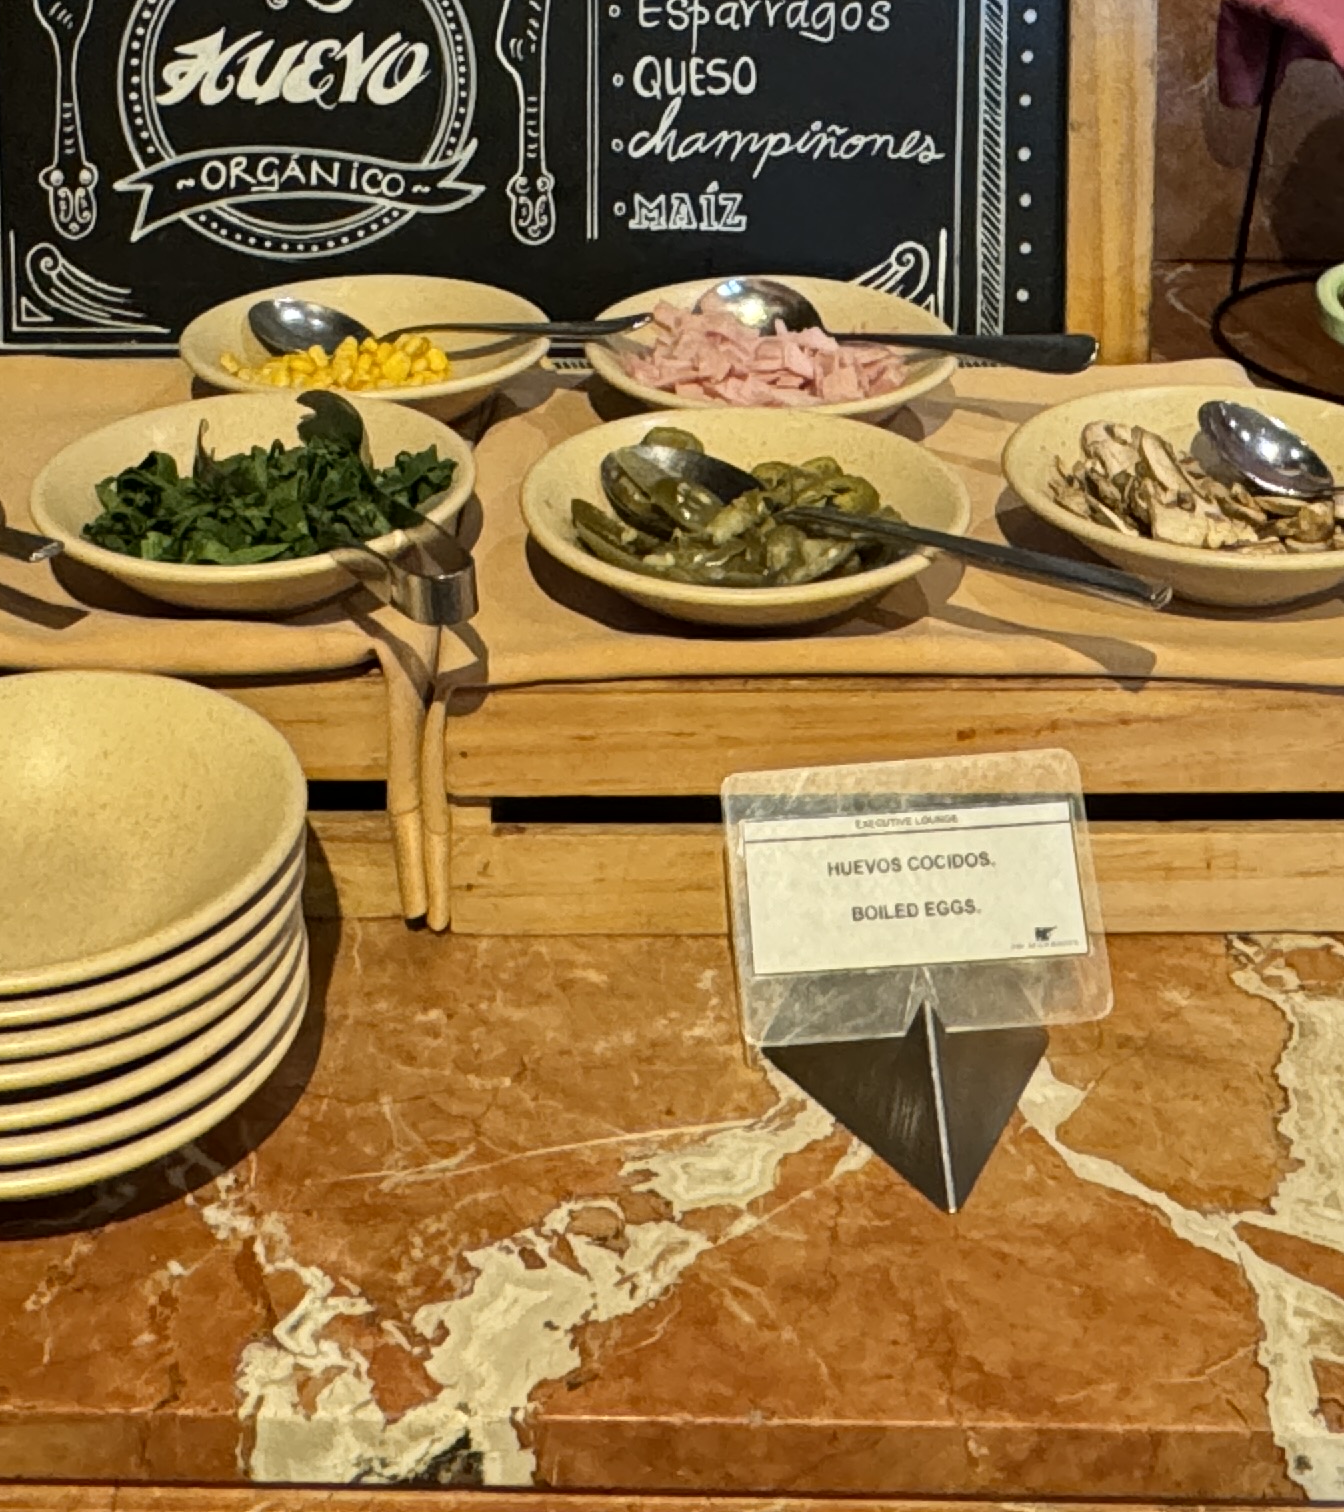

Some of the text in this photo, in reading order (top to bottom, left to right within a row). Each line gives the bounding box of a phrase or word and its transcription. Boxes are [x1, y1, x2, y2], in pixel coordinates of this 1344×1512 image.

[156, 26, 431, 109] HUEVO
[632, 55, 757, 101] QUESO
[628, 180, 747, 232] MAÍZ
[827, 856, 902, 877] HUEVOS
[851, 903, 919, 922] BOILED
